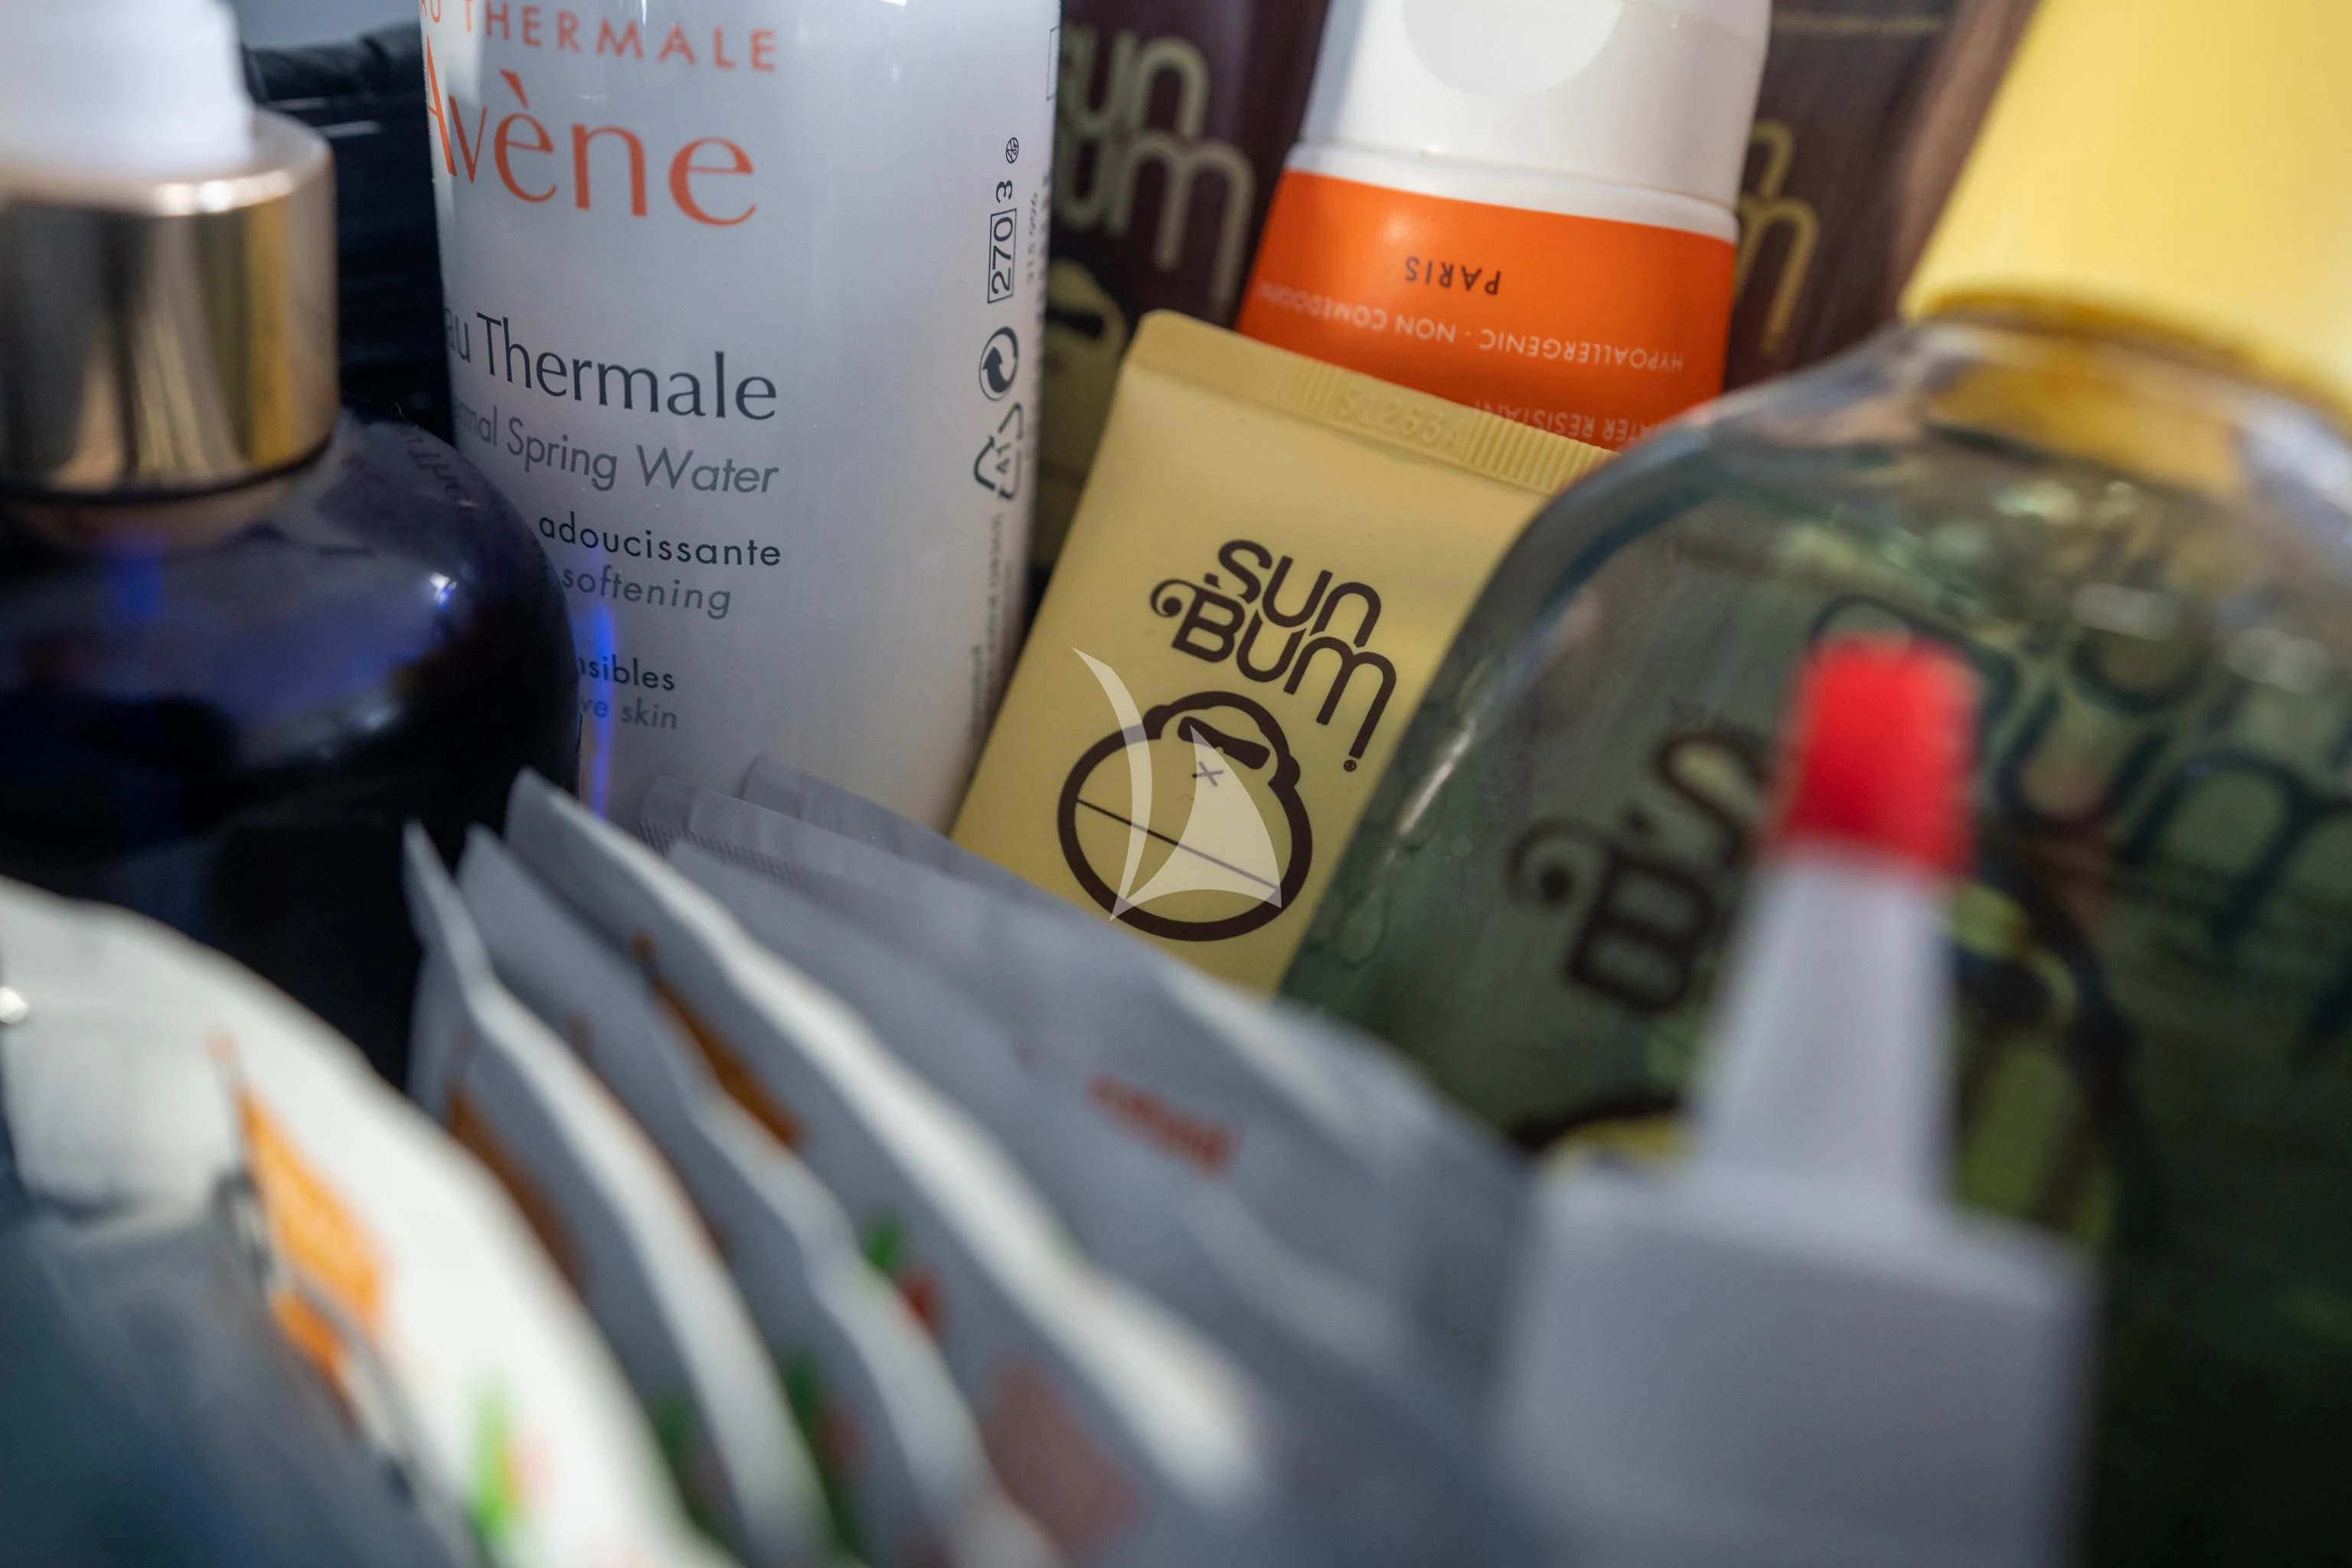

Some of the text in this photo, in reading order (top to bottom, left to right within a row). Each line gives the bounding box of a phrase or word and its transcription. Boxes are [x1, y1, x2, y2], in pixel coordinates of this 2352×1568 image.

[464, 0, 776, 70] THERMALE
[426, 35, 757, 226] Avène
[991, 180, 1014, 295] 270 3
[1406, 256, 1501, 296] PARIS
[1394, 314, 1456, 343] NON
[1478, 328, 1684, 373] HYPOALLERGENIC
[475, 311, 776, 420] Thermale
[507, 416, 617, 492] Spring
[636, 444, 779, 493] Water
[538, 511, 781, 567] adoucissante
[562, 564, 731, 619] softening
[621, 697, 677, 730] skin
